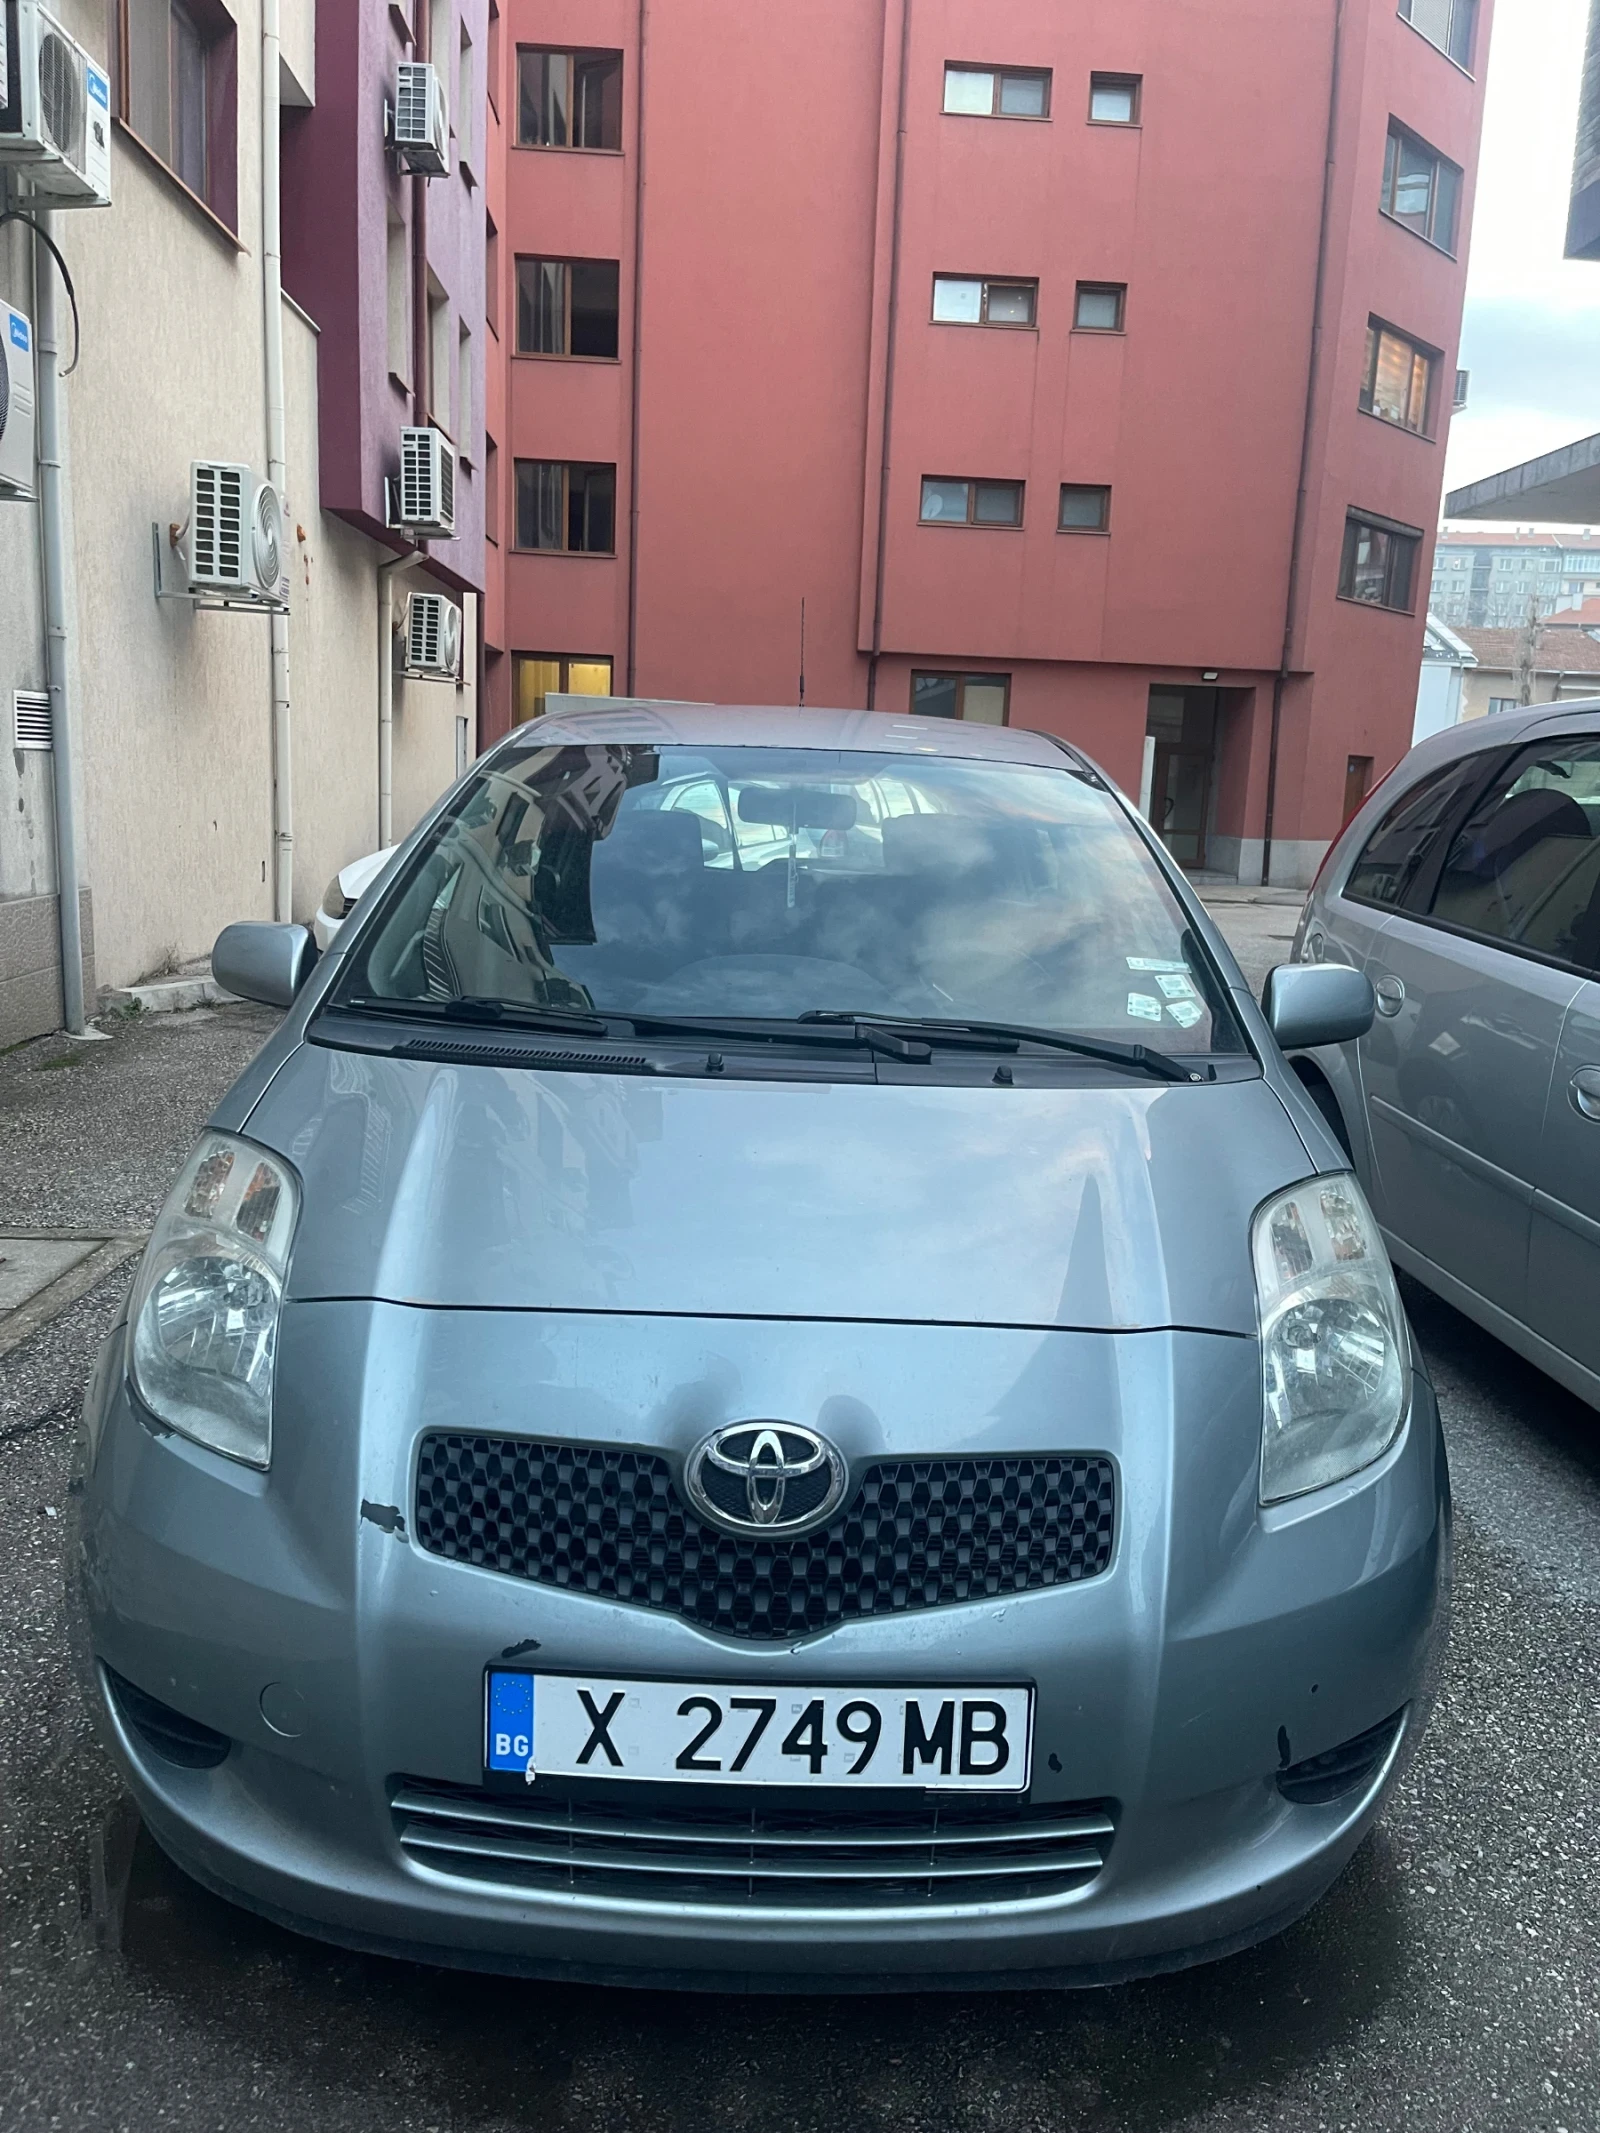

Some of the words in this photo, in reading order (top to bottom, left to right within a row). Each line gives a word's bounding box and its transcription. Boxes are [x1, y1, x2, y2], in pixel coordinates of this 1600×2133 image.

[495, 1733, 529, 1757] BG
[576, 1688, 626, 1767] X
[675, 1696, 883, 1774] 2749
[902, 1699, 1010, 1776] MB
